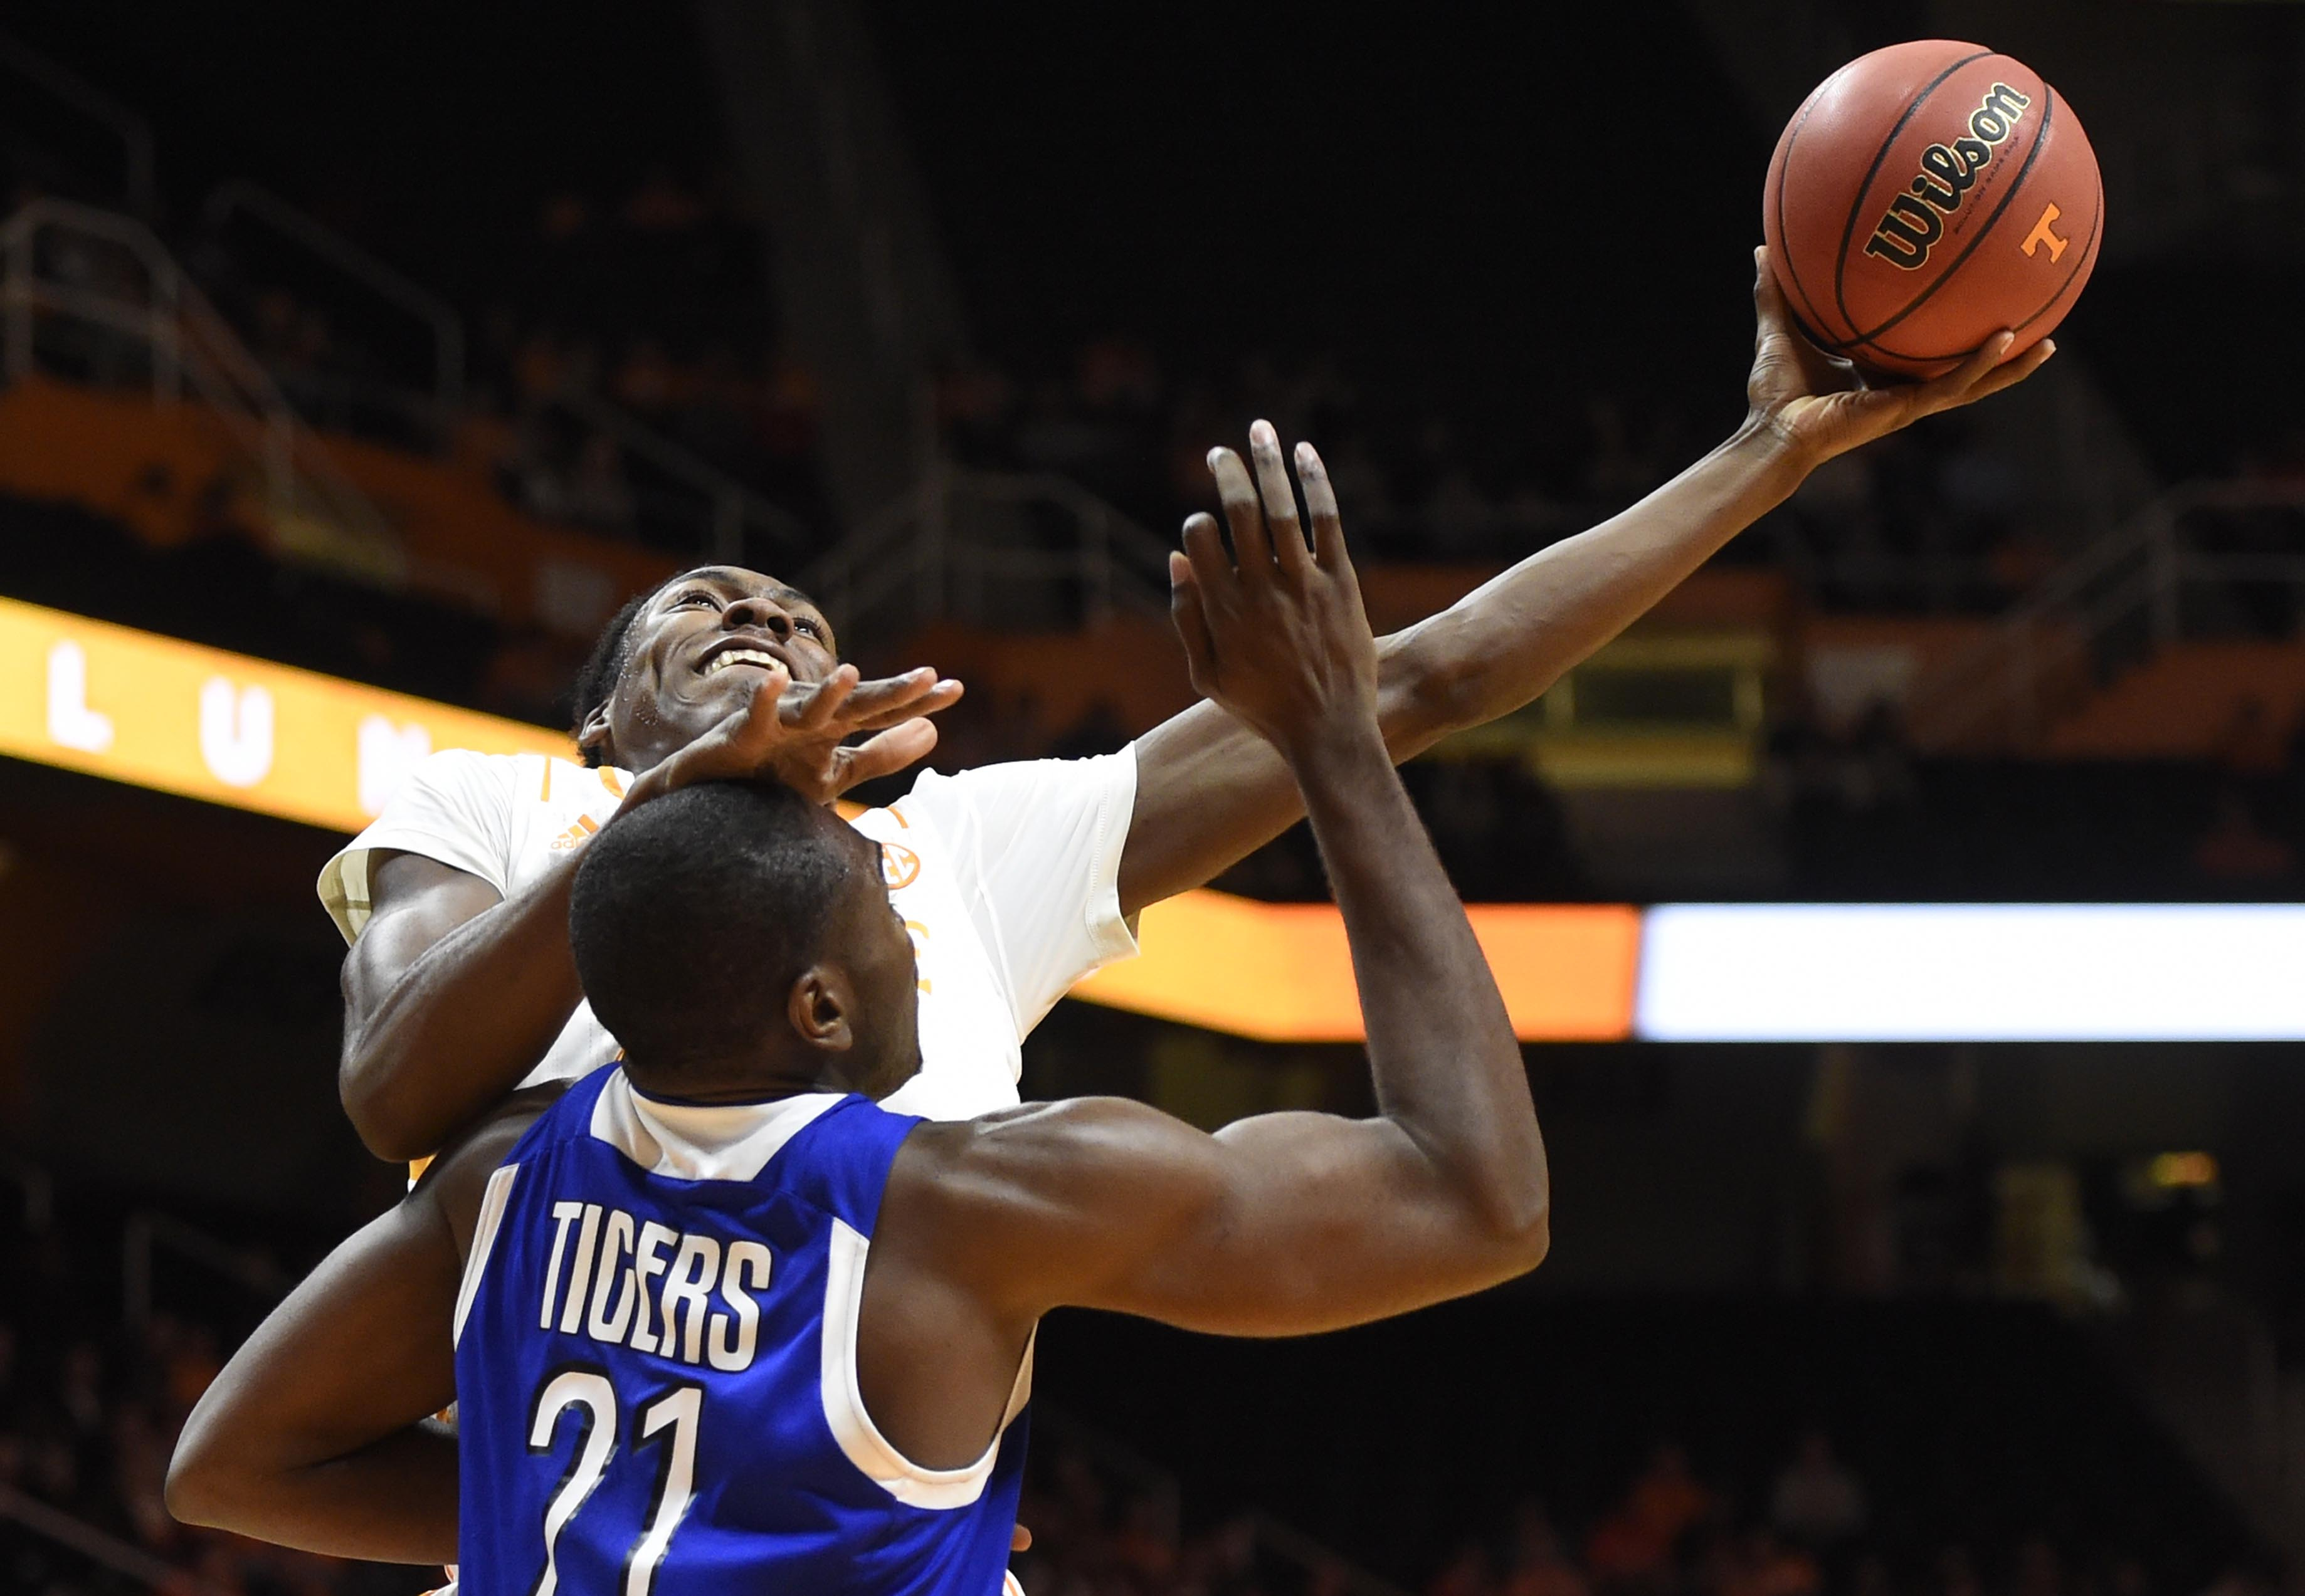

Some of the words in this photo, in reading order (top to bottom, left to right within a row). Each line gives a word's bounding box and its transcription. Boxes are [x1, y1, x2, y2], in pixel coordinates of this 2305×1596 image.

[1862, 81, 2031, 270] Wilson
[2020, 202, 2068, 264] T
[539, 1199, 773, 1373] TIGERS
[528, 1368, 704, 1596] 21
